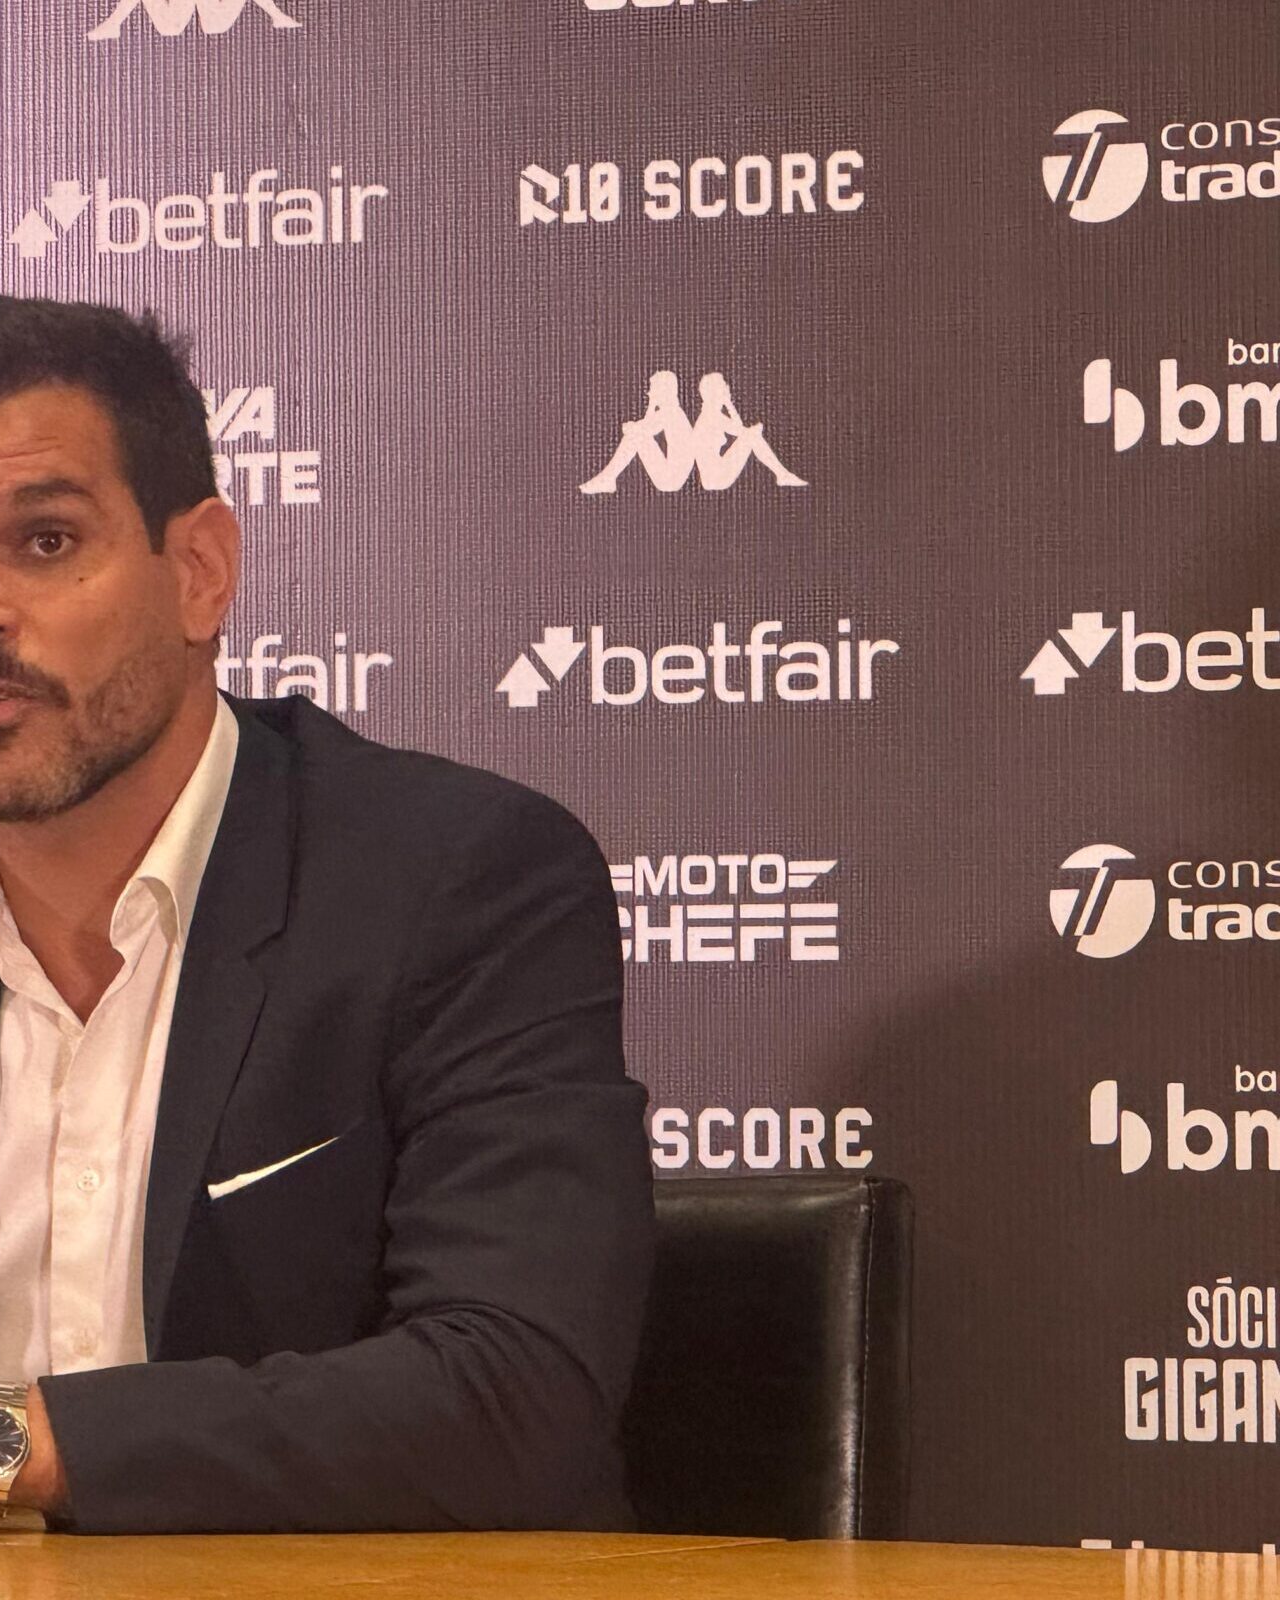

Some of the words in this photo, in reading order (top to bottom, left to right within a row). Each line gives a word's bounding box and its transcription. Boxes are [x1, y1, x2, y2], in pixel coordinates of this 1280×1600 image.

[1161, 118, 1280, 151] cons
[643, 150, 864, 221] SCORE
[1161, 150, 1280, 202] trad
[96, 165, 389, 254] betfair
[201, 386, 276, 441] VA
[214, 632, 394, 713] tfair
[591, 618, 901, 706] betfair
[1122, 607, 1280, 693] bet
[634, 853, 787, 896] MOTO
[617, 903, 840, 963] HEFE
[651, 1107, 874, 1169] SCORE
[1187, 1276, 1277, 1349] SÓCI
